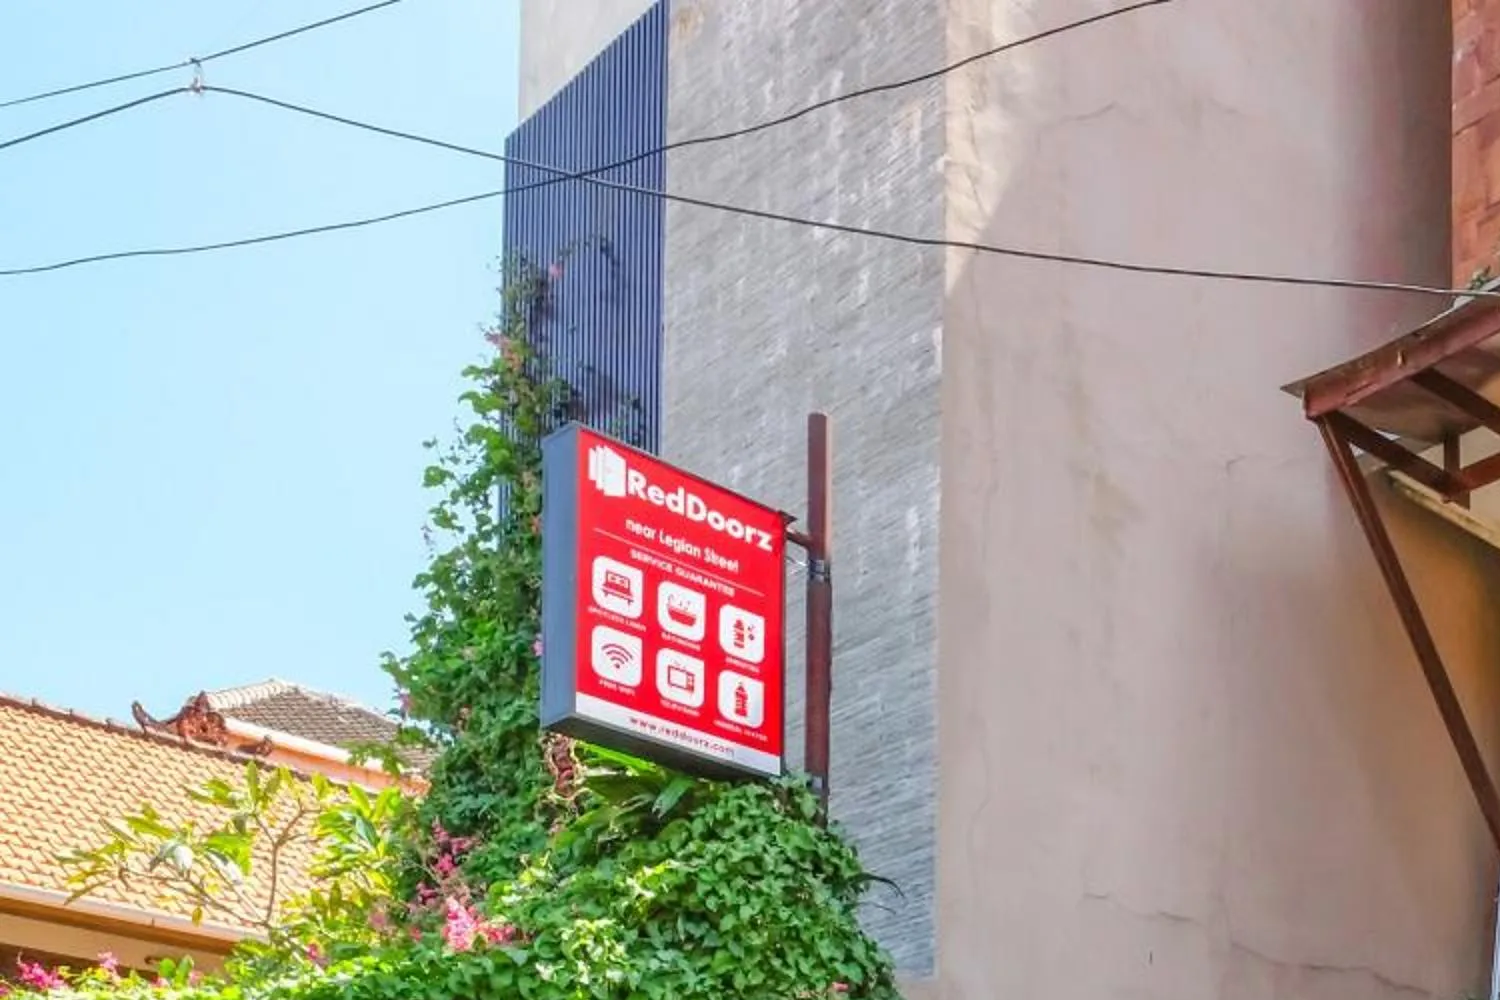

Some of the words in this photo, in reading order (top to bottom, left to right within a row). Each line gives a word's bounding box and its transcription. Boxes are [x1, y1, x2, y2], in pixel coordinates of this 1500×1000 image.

[624, 518, 657, 541] near
[659, 528, 702, 559] Legian
[628, 468, 773, 552] RedDoorz
